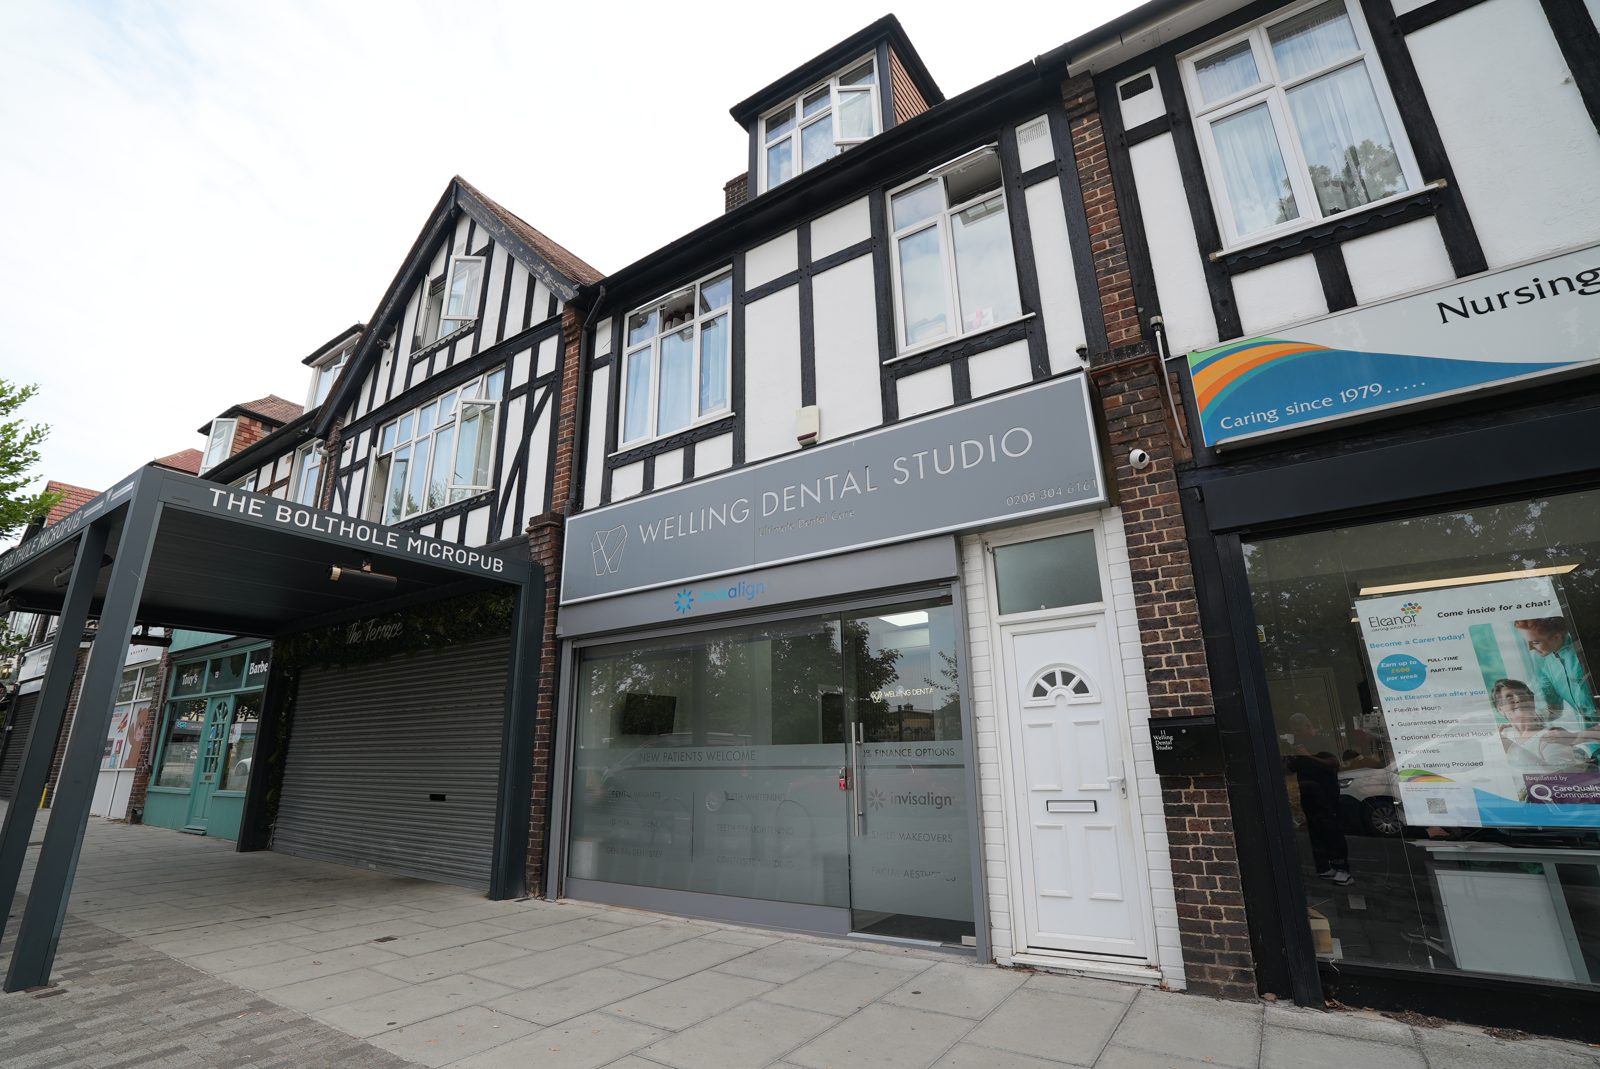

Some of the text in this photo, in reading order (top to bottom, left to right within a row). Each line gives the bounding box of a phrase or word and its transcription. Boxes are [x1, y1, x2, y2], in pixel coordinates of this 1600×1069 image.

[1436, 267, 1600, 324] Nursing
[1219, 406, 1280, 432] Caring
[1286, 394, 1334, 417] since
[639, 427, 1033, 545] WELLING DENTAL STUDIO
[1006, 492, 1036, 506] 0208
[1040, 487, 1062, 500] 304
[831, 509, 856, 521] Care
[209, 487, 504, 573] THE BOLTHOLE MICROPUB
[1437, 610, 1464, 618] Come
[1466, 606, 1496, 615] inside
[1525, 600, 1551, 608] chat!
[1368, 613, 1418, 628] Eleanor
[1369, 640, 1402, 649] Become
[1438, 633, 1465, 641] today!
[248, 660, 269, 675] Barbe
[639, 750, 756, 762] NEW PATIENTS WELCOME
[874, 748, 912, 758] FINANCE
[915, 747, 955, 757] OPTIONS
[890, 791, 952, 809] invisalign
[898, 832, 953, 843] MAKEOVERS
